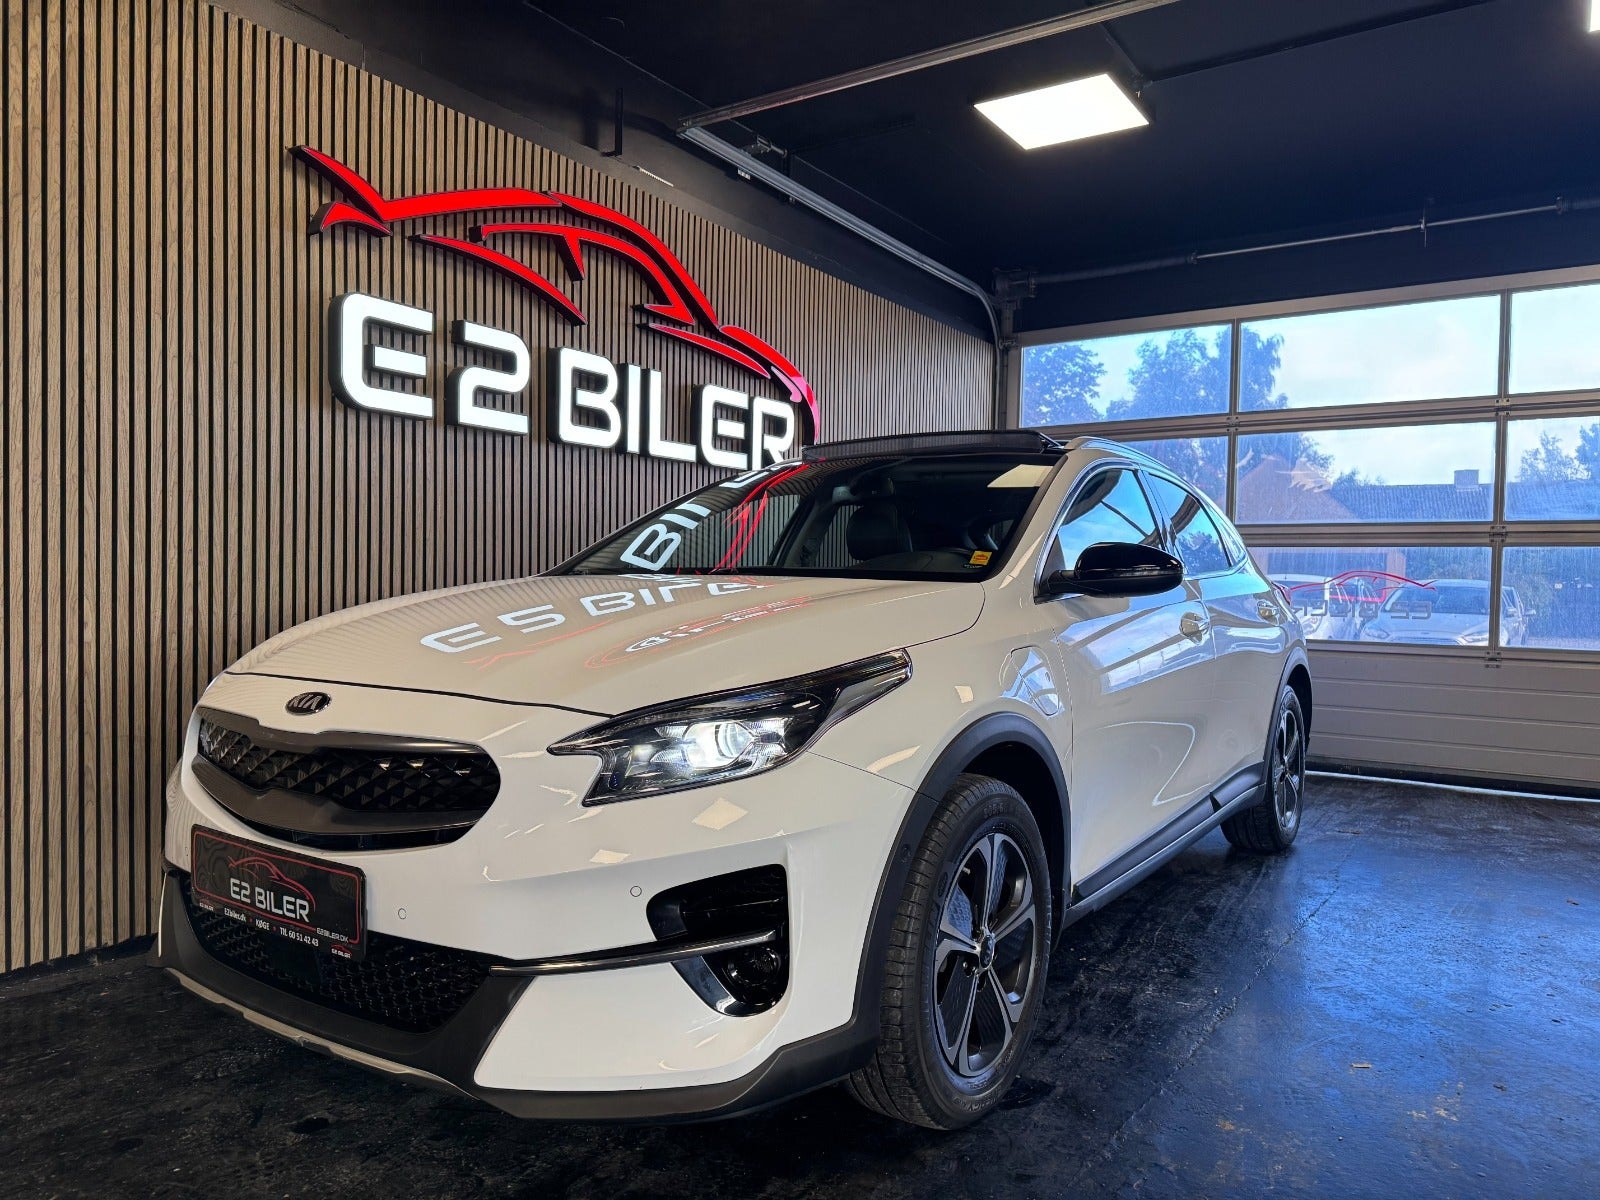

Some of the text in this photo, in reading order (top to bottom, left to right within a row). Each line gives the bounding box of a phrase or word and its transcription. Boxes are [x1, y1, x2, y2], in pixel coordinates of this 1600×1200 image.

[337, 292, 796, 471] E2 BILER
[229, 877, 310, 923] E2 BILER
